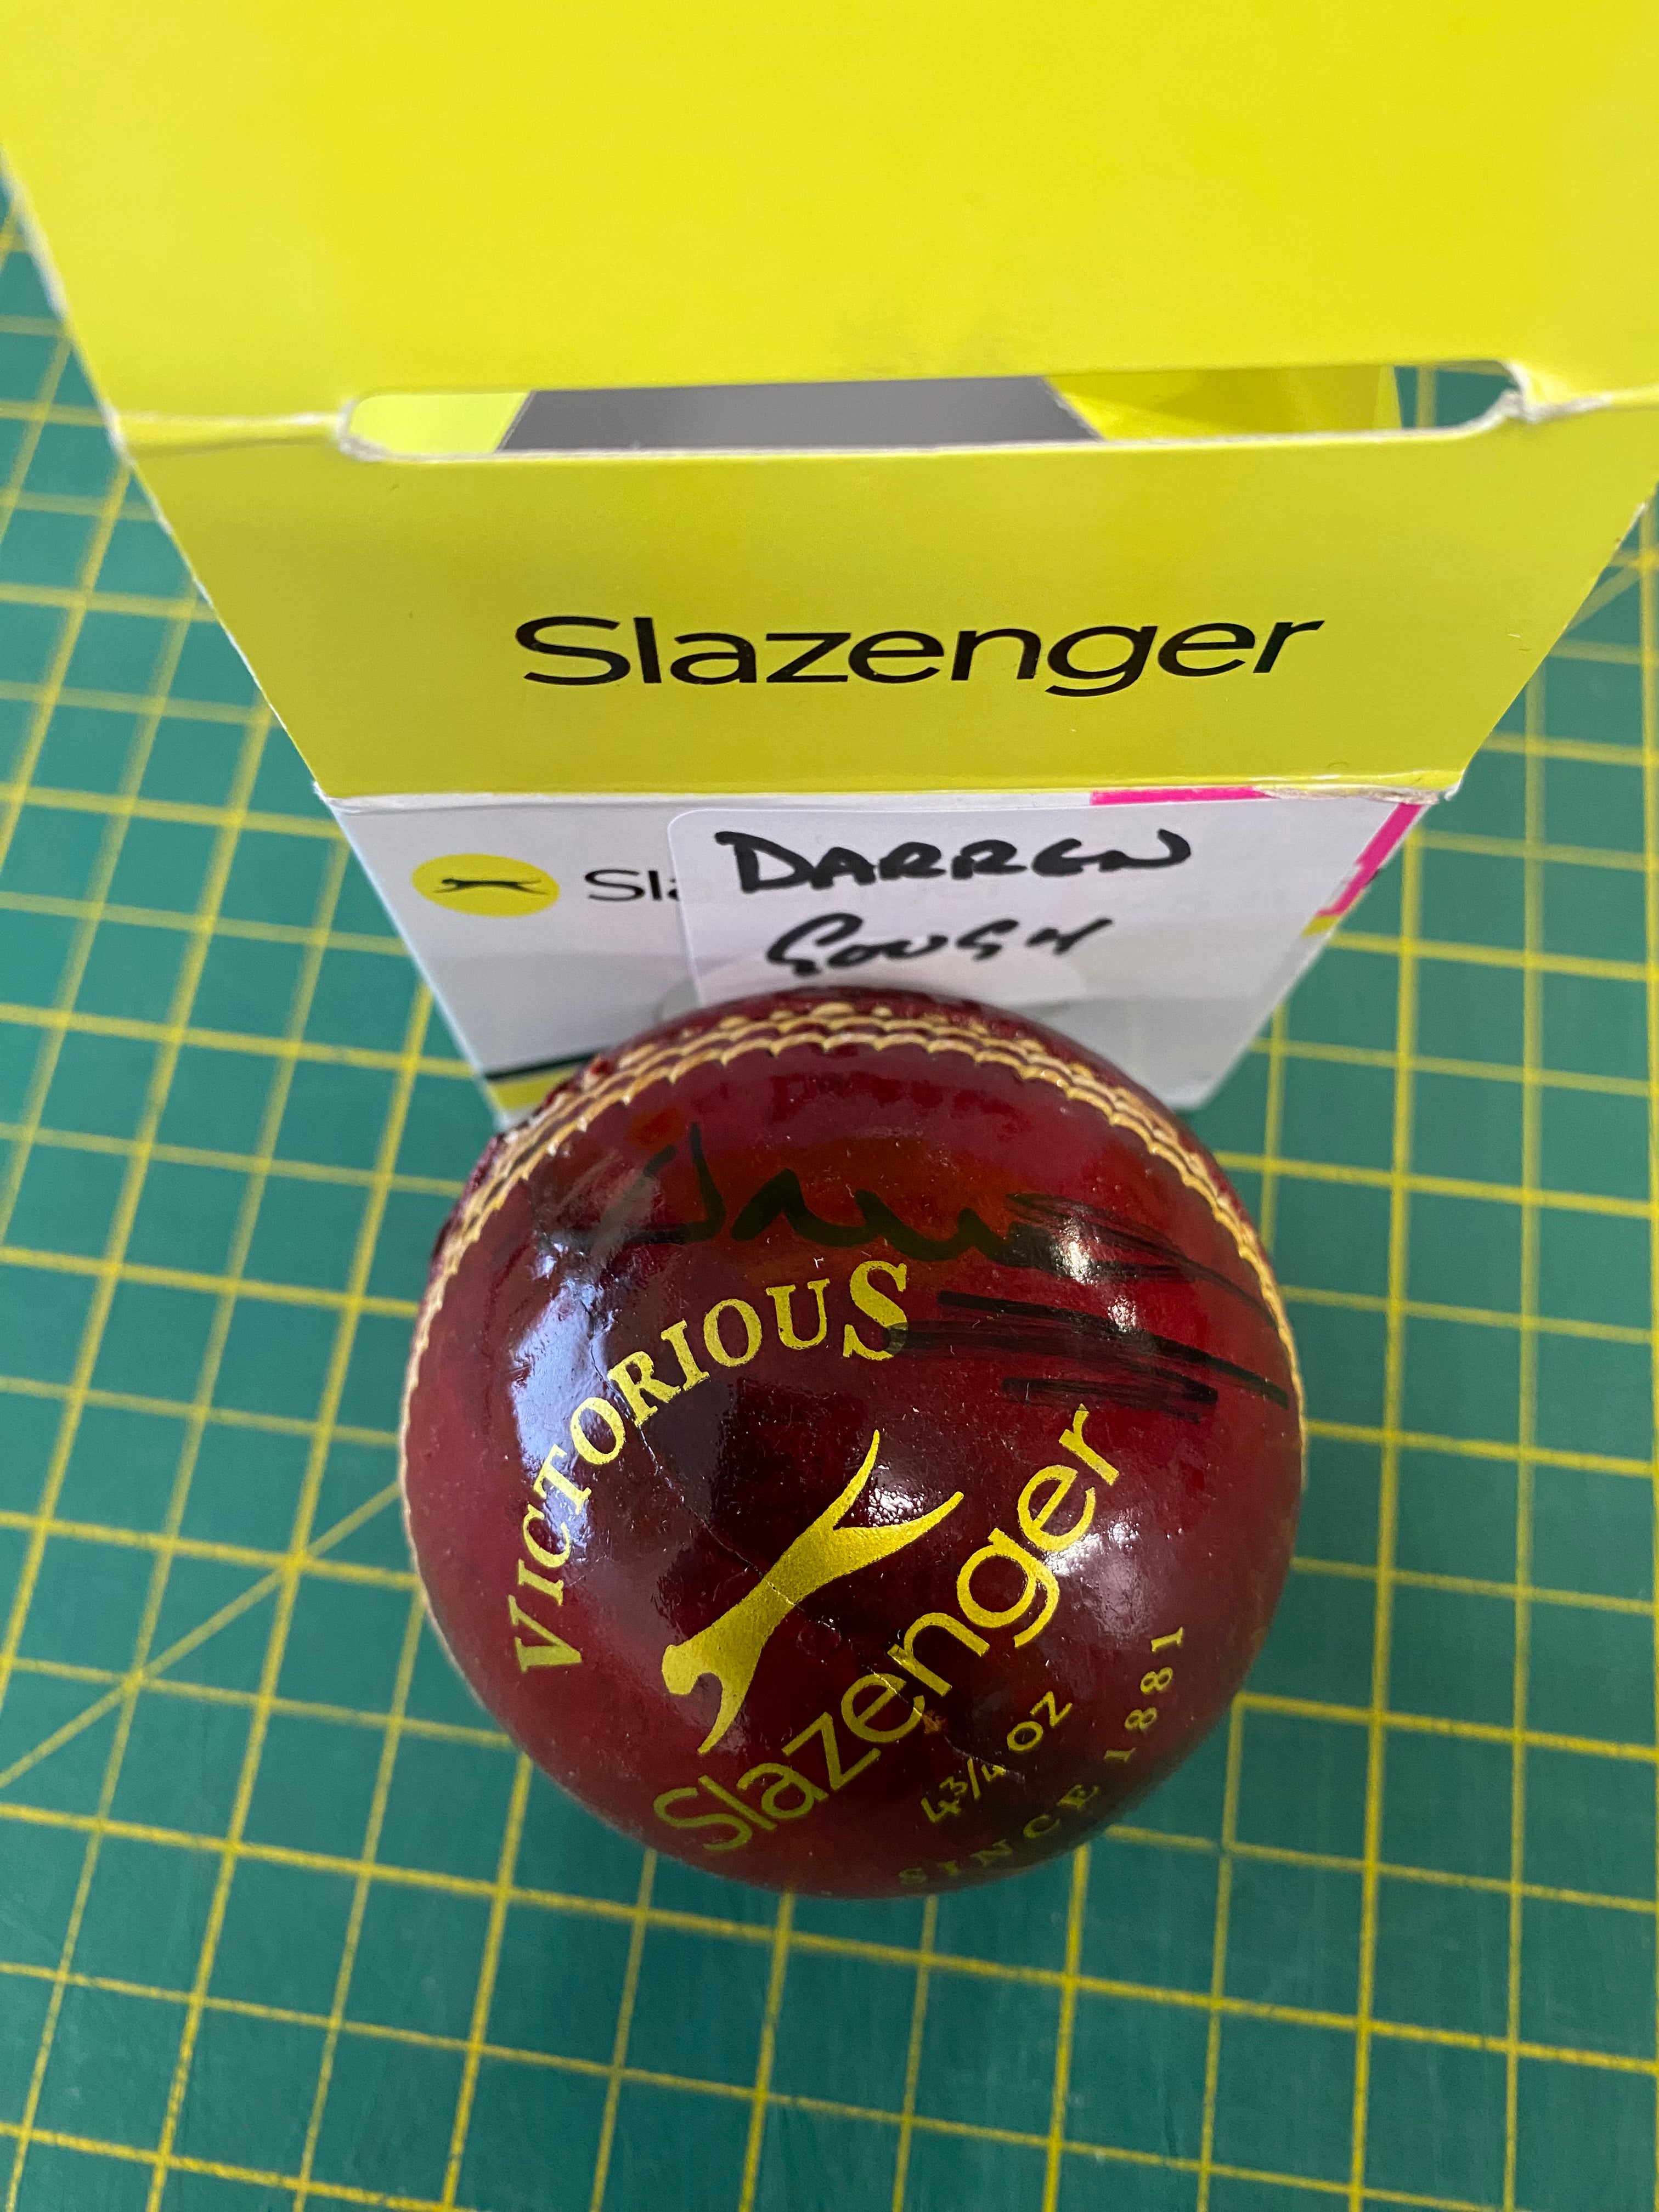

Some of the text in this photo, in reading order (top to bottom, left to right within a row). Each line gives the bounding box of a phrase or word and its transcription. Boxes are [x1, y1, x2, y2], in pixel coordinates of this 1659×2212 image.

[515, 615, 1325, 697] Slazenger
[584, 868, 679, 902] Sl
[714, 829, 1192, 893] DARREN
[507, 1260, 909, 1673] VICTORIOUS
[653, 1403, 1121, 1852] Slazenger
[898, 1626, 1184, 1885] SINCE 1881
